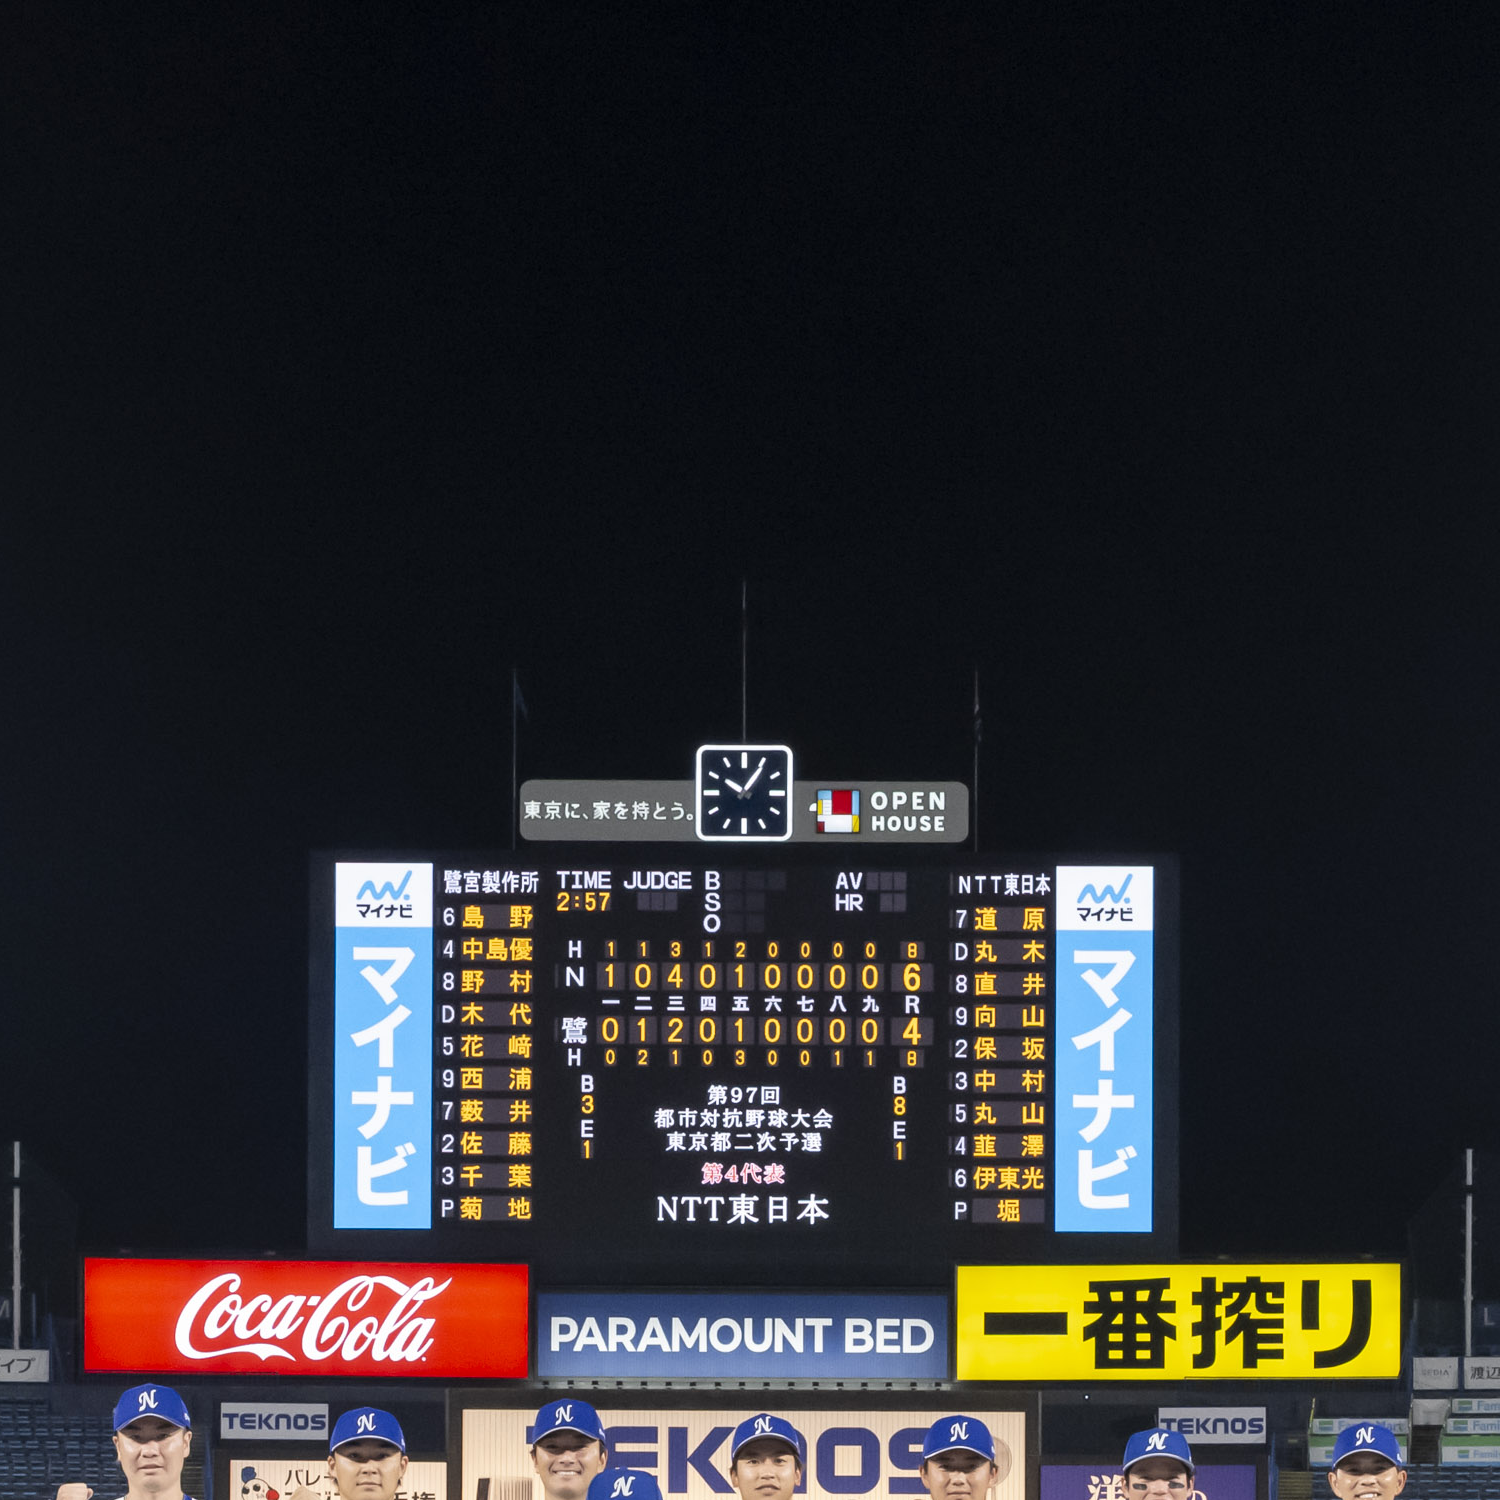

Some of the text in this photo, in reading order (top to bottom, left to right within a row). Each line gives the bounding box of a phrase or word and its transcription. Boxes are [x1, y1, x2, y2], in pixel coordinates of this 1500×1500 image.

[523, 799, 694, 821] 東京に、家を持とう。
[870, 791, 945, 811] OPEN
[871, 815, 945, 832] HOUSE
[443, 869, 540, 894] 鷺宮製作所
[556, 870, 612, 890] TIME
[623, 871, 693, 890] JUDGE
[704, 870, 721, 891] B
[835, 871, 863, 890] AV
[356, 903, 413, 919] マイナビ
[556, 891, 610, 912] 2:57
[704, 892, 721, 912] S
[835, 893, 864, 912] HR
[703, 913, 721, 933] O
[1076, 907, 1133, 922] マイナビ
[462, 937, 533, 962] 中島優
[565, 962, 921, 991] N 1 0 4 0 1 0 0 0 0 6
[601, 1017, 619, 1043] 0
[637, 1017, 646, 1042] 1
[667, 1017, 684, 1043] 2
[699, 1017, 716, 1043] 0
[734, 1017, 743, 1043] 1
[764, 1017, 781, 1043] 0
[796, 1018, 814, 1044] 0
[829, 1018, 846, 1044] 0
[861, 1018, 878, 1044] 0
[902, 1017, 922, 1046] 4
[350, 946, 417, 1206] マイナビ
[1071, 950, 1138, 1210] マイナビ
[707, 1084, 781, 1106] 第97回
[654, 1107, 834, 1129] 都市対抗野球大会
[665, 1131, 822, 1153] 東京都二次予選
[701, 1162, 786, 1185] 第4代表
[972, 1165, 1045, 1191] 伊東光
[657, 1193, 830, 1225] NTT東日本
[996, 1199, 1021, 1223] 堀
[174, 1273, 453, 1362] Coca-Cola
[550, 1316, 935, 1354] PARAMOUNT BED
[222, 1413, 327, 1430] TEKNOS
[1160, 1416, 1264, 1434] TEKNOS
